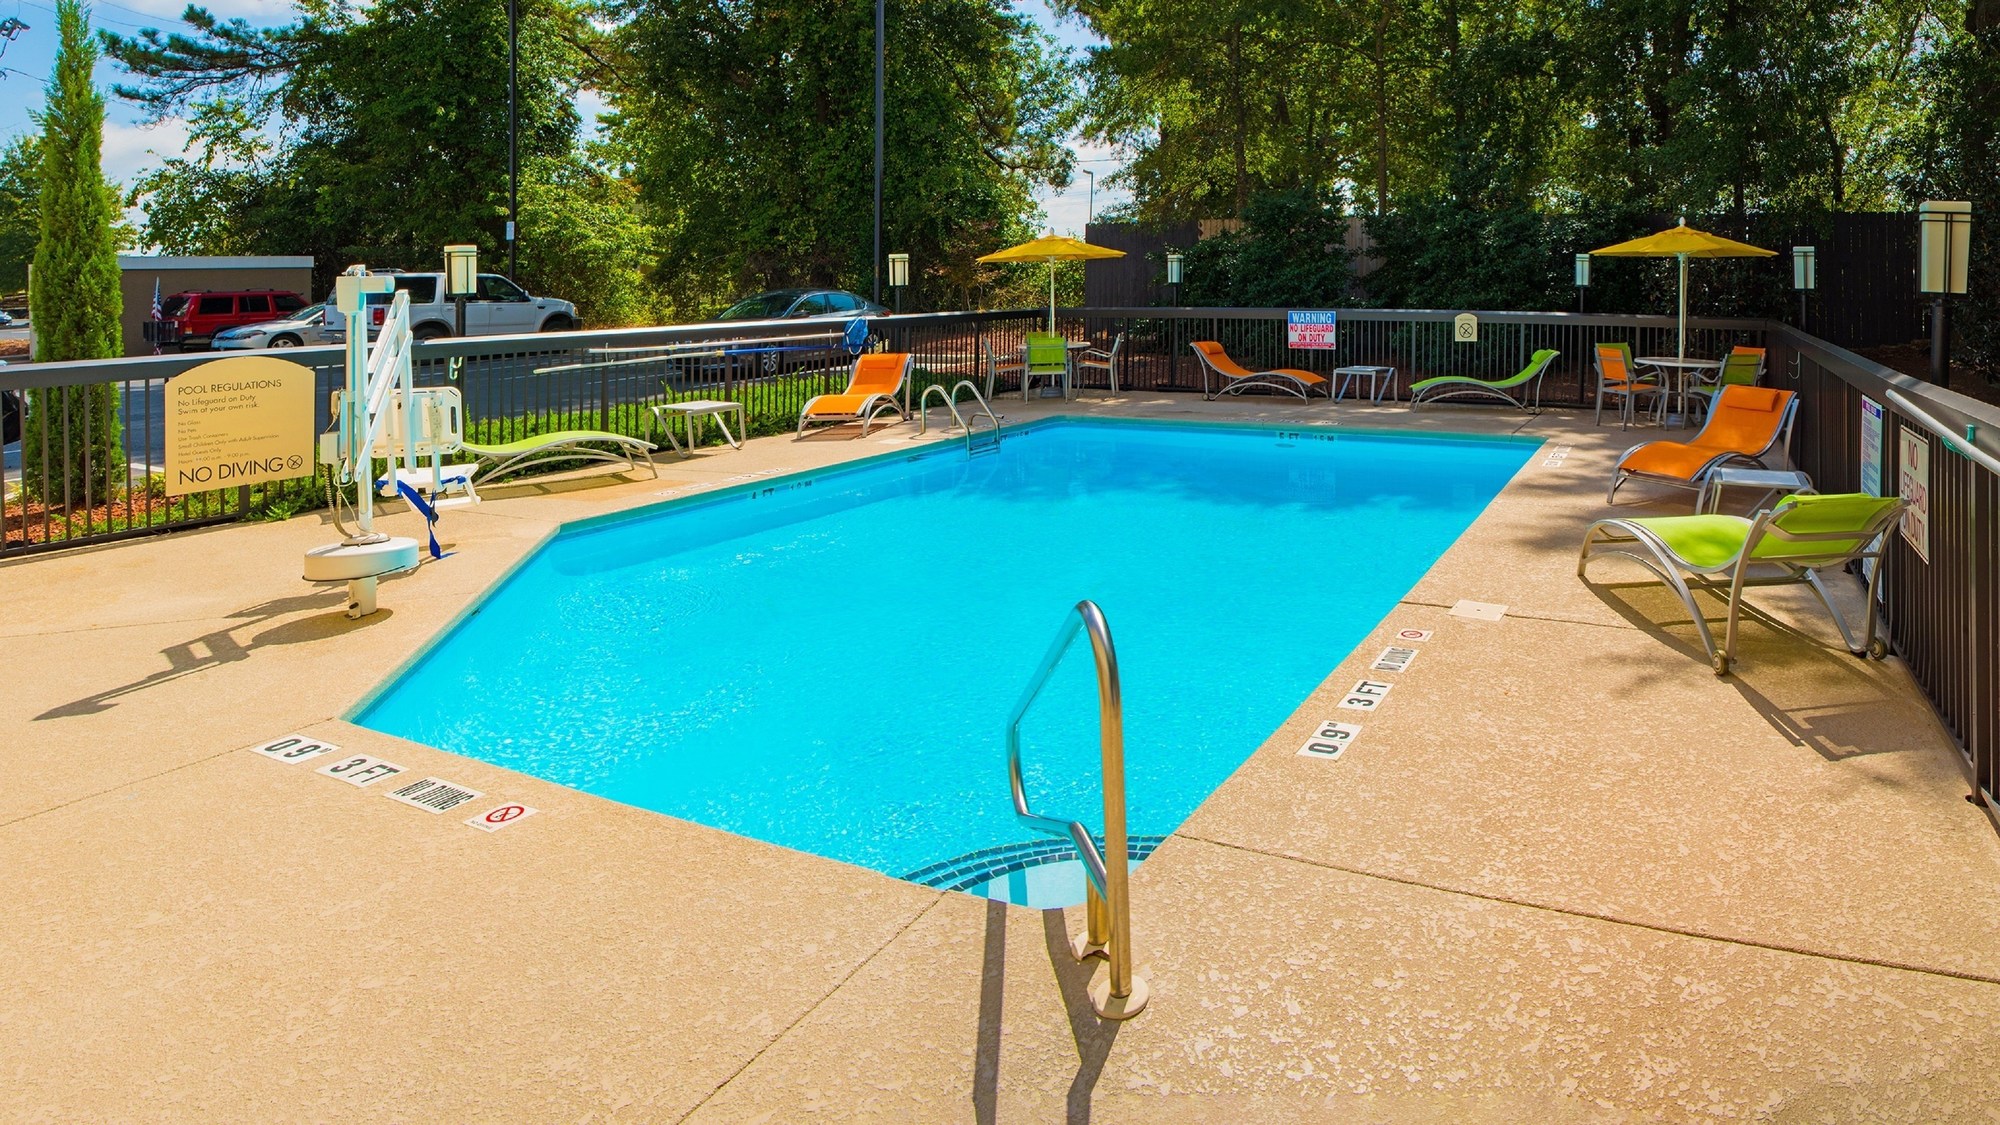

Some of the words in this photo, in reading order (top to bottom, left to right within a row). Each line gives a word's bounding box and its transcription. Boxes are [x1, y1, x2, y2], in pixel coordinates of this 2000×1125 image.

[1292, 313, 1332, 324] WARNING
[1290, 324, 1298, 333] NO
[1300, 324, 1334, 333] LIFEGUARD
[1298, 333, 1306, 342] ON
[1309, 333, 1325, 342] DUTY
[178, 385, 208, 396] POOL
[210, 379, 282, 393] REGULATIONS
[192, 396, 226, 407] Lifeguard
[240, 394, 256, 402] Duty
[178, 407, 198, 416] Swim
[200, 406, 208, 414] at
[209, 405, 226, 415] your
[228, 403, 244, 411] own
[1288, 432, 1300, 440] FT
[1907, 439, 1918, 471] NO
[179, 466, 213, 485] NO
[219, 457, 284, 480] DIVING
[762, 487, 775, 497] FT
[1900, 467, 1926, 515] LIFEGUARD
[1911, 511, 1925, 550] DUTY
[1355, 681, 1388, 696] FT
[1347, 697, 1374, 707] 3
[330, 758, 367, 774] 3
[347, 764, 401, 784] FT
[392, 779, 437, 798] NO
[410, 784, 475, 811] DIVING
